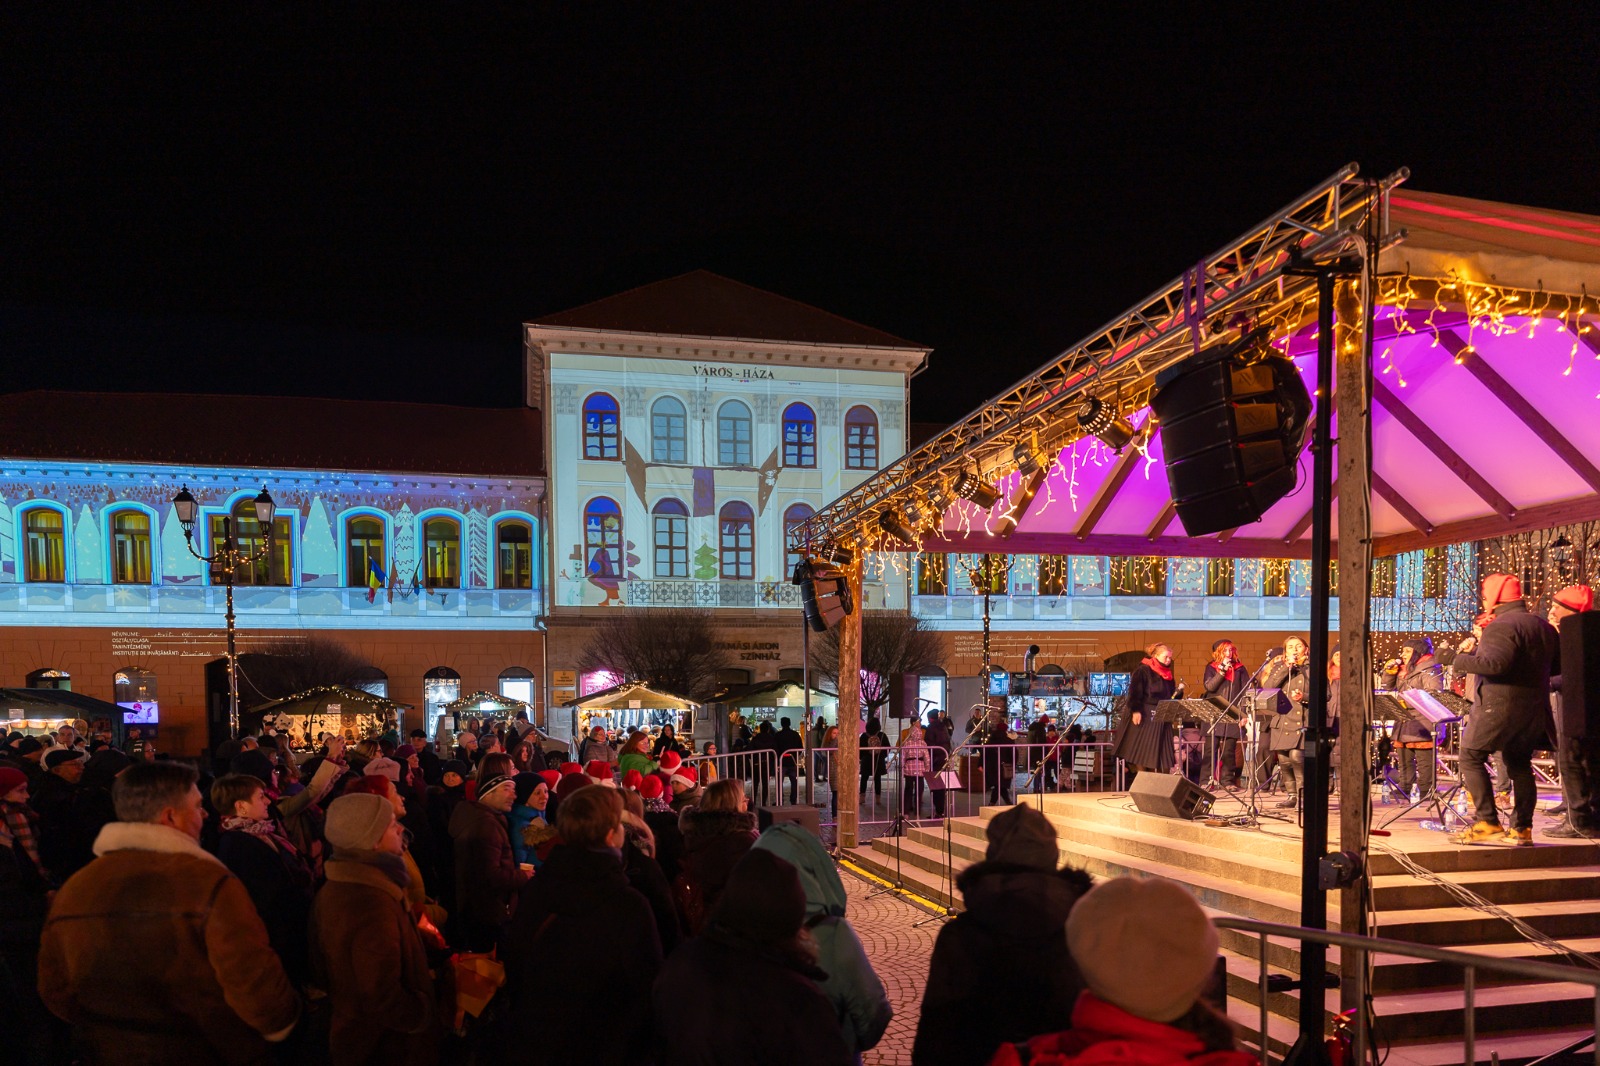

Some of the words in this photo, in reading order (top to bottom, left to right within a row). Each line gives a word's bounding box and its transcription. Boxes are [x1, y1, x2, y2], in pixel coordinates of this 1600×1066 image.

[692, 364, 733, 377] VÁROS
[743, 367, 774, 379] HÁZA
[752, 641, 779, 650] ÁRON
[740, 651, 781, 661] SZÍNHÁZ
